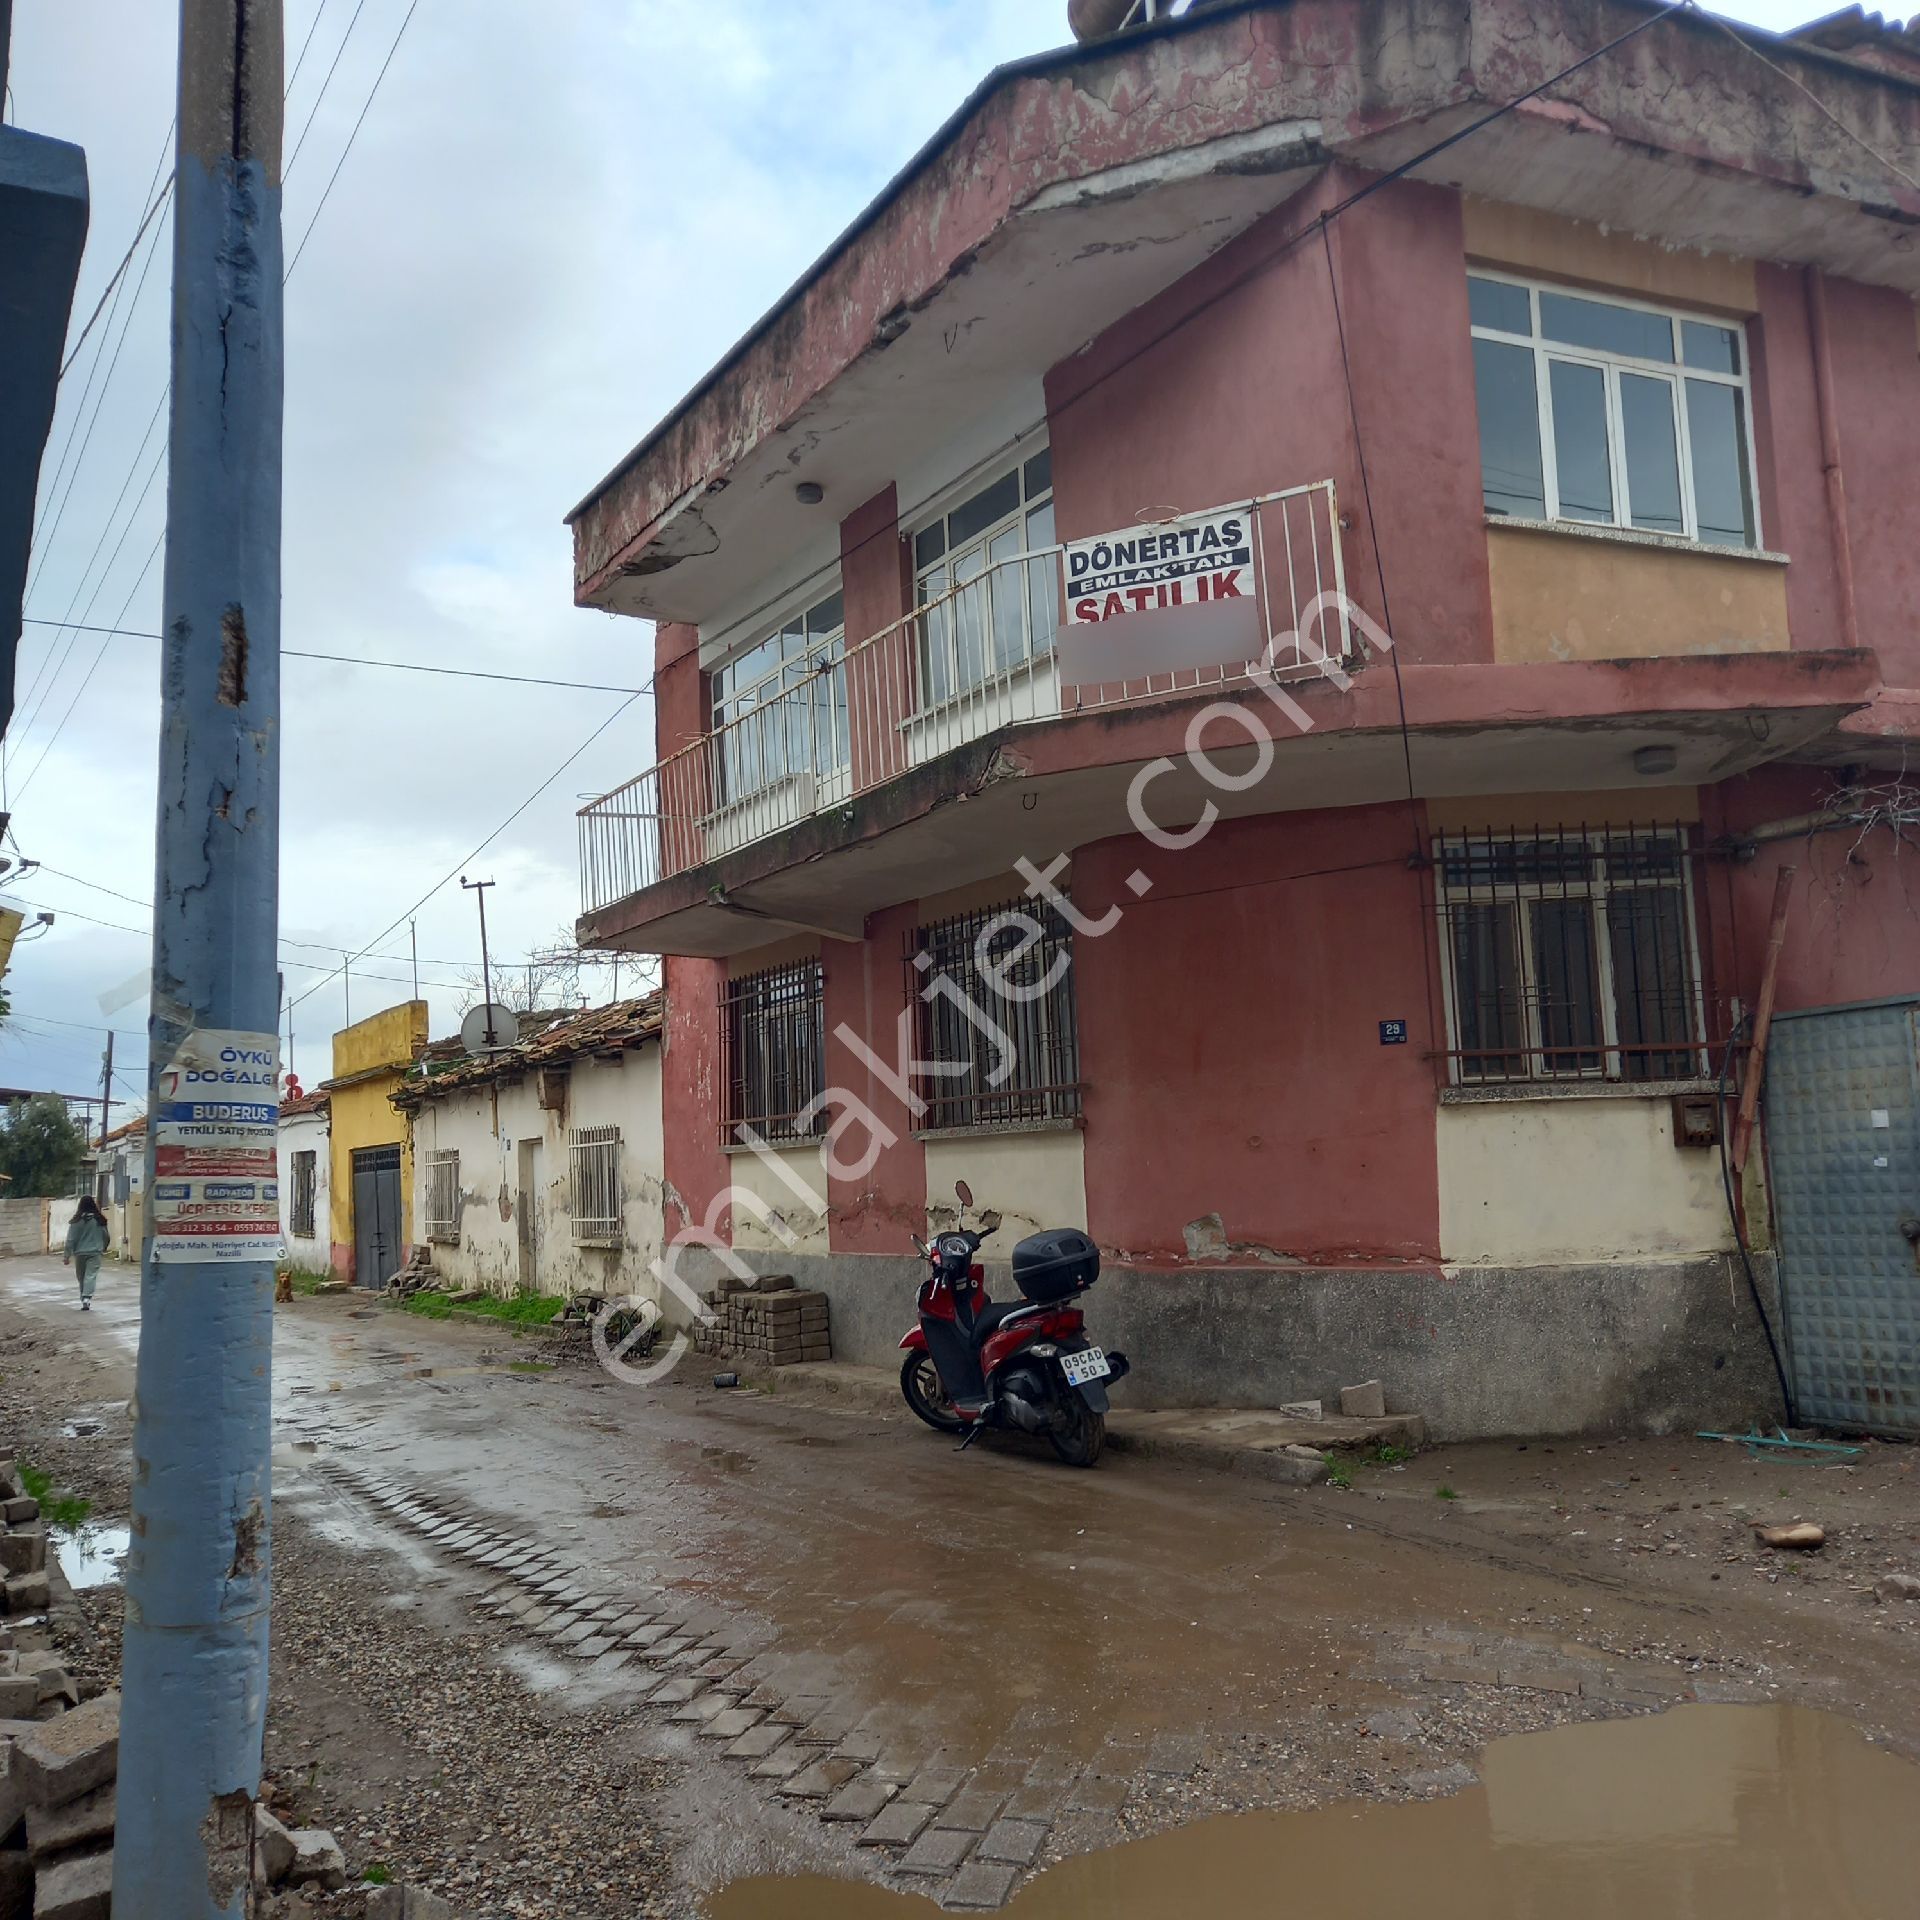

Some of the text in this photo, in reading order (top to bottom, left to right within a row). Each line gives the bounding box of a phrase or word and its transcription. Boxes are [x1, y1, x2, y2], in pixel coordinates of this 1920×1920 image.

[1070, 519, 1243, 577] DÖNERTAŞ
[1080, 552, 1234, 594] EMLAK'TAN
[1075, 568, 1244, 625] SATILIK
[1386, 1023, 1400, 1035] 29
[220, 1046, 272, 1065] ÖYKÜ
[193, 1105, 269, 1121] BUDERUS
[178, 1124, 215, 1135] YETKİLİ
[206, 1186, 254, 1198] RADYATÖR
[182, 1224, 199, 1232] 312
[201, 1224, 213, 1232] 36
[215, 1224, 226, 1232] 54
[187, 1242, 209, 1250] Mah.
[212, 1241, 246, 1250] Hürriyet
